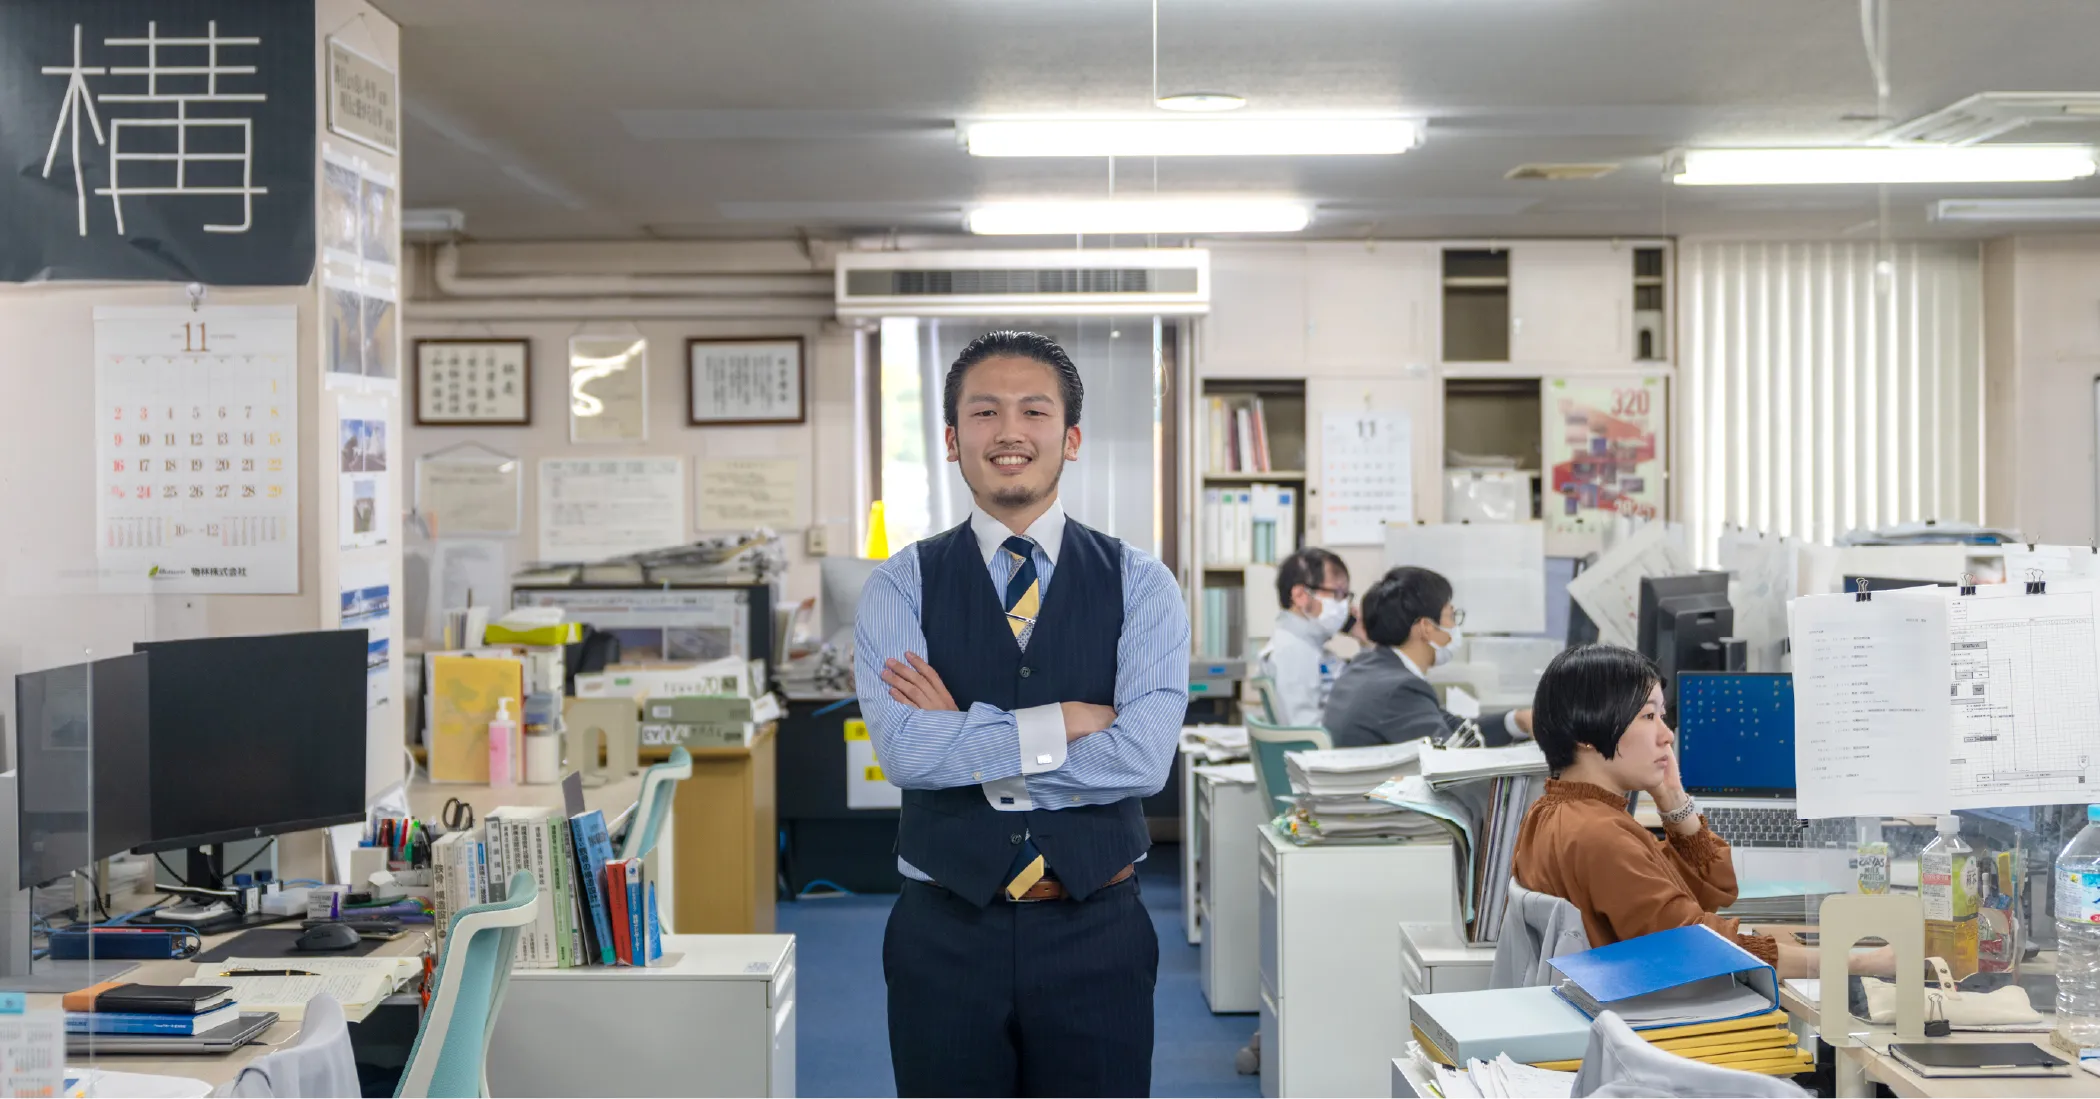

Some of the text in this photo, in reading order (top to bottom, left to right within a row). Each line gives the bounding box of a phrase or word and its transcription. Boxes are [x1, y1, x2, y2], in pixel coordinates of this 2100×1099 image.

[42, 20, 268, 237] 構
[182, 321, 211, 352] 11
[1611, 389, 1651, 416] 320
[114, 407, 122, 420] 2
[139, 407, 148, 420] 3
[192, 407, 201, 420] 5
[218, 407, 227, 420] 6
[244, 406, 252, 420] 7
[1356, 420, 1376, 438] 11
[113, 433, 282, 446] 9 10 11 12 13 14 15
[113, 460, 125, 472] 16
[138, 459, 151, 472] 17
[165, 460, 177, 472] 18
[190, 459, 203, 472] 19
[215, 460, 231, 472] 20
[241, 459, 254, 472] 21
[136, 486, 151, 499] 24
[163, 486, 178, 499] 25
[189, 486, 204, 499] 26
[215, 485, 230, 499] 27
[242, 486, 256, 499] 28
[191, 567, 247, 577] 物林株式会社
